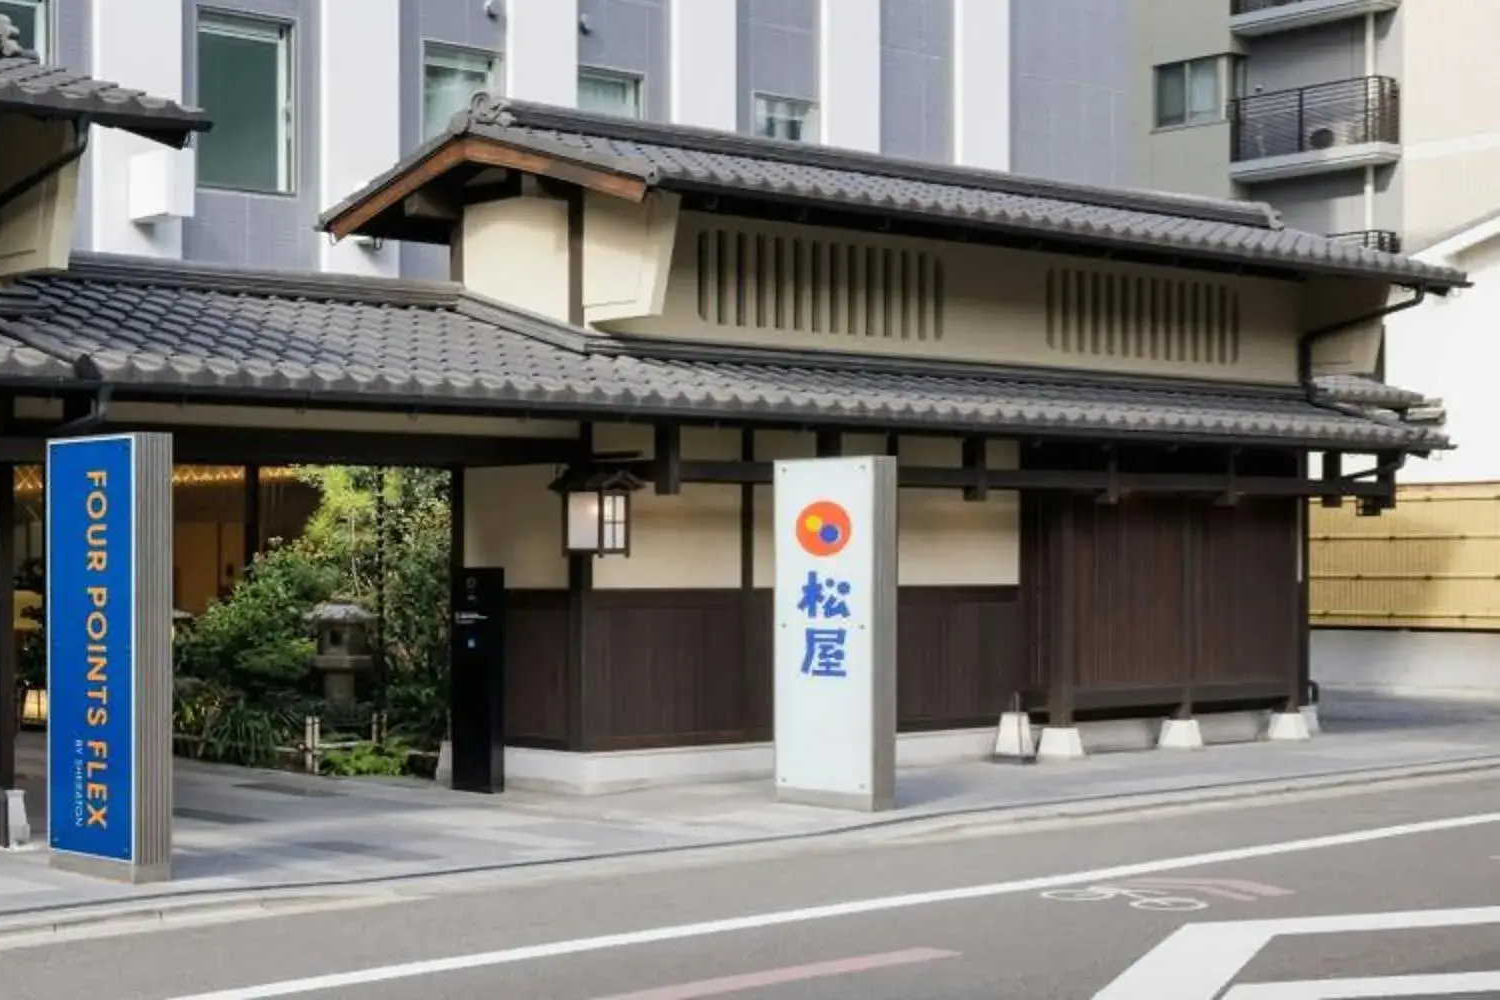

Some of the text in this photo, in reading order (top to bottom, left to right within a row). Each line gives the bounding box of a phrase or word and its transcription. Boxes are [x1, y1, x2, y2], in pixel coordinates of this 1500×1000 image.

[86, 470, 108, 829] FOUR POINTS FLEX
[797, 570, 852, 678] 松屋
